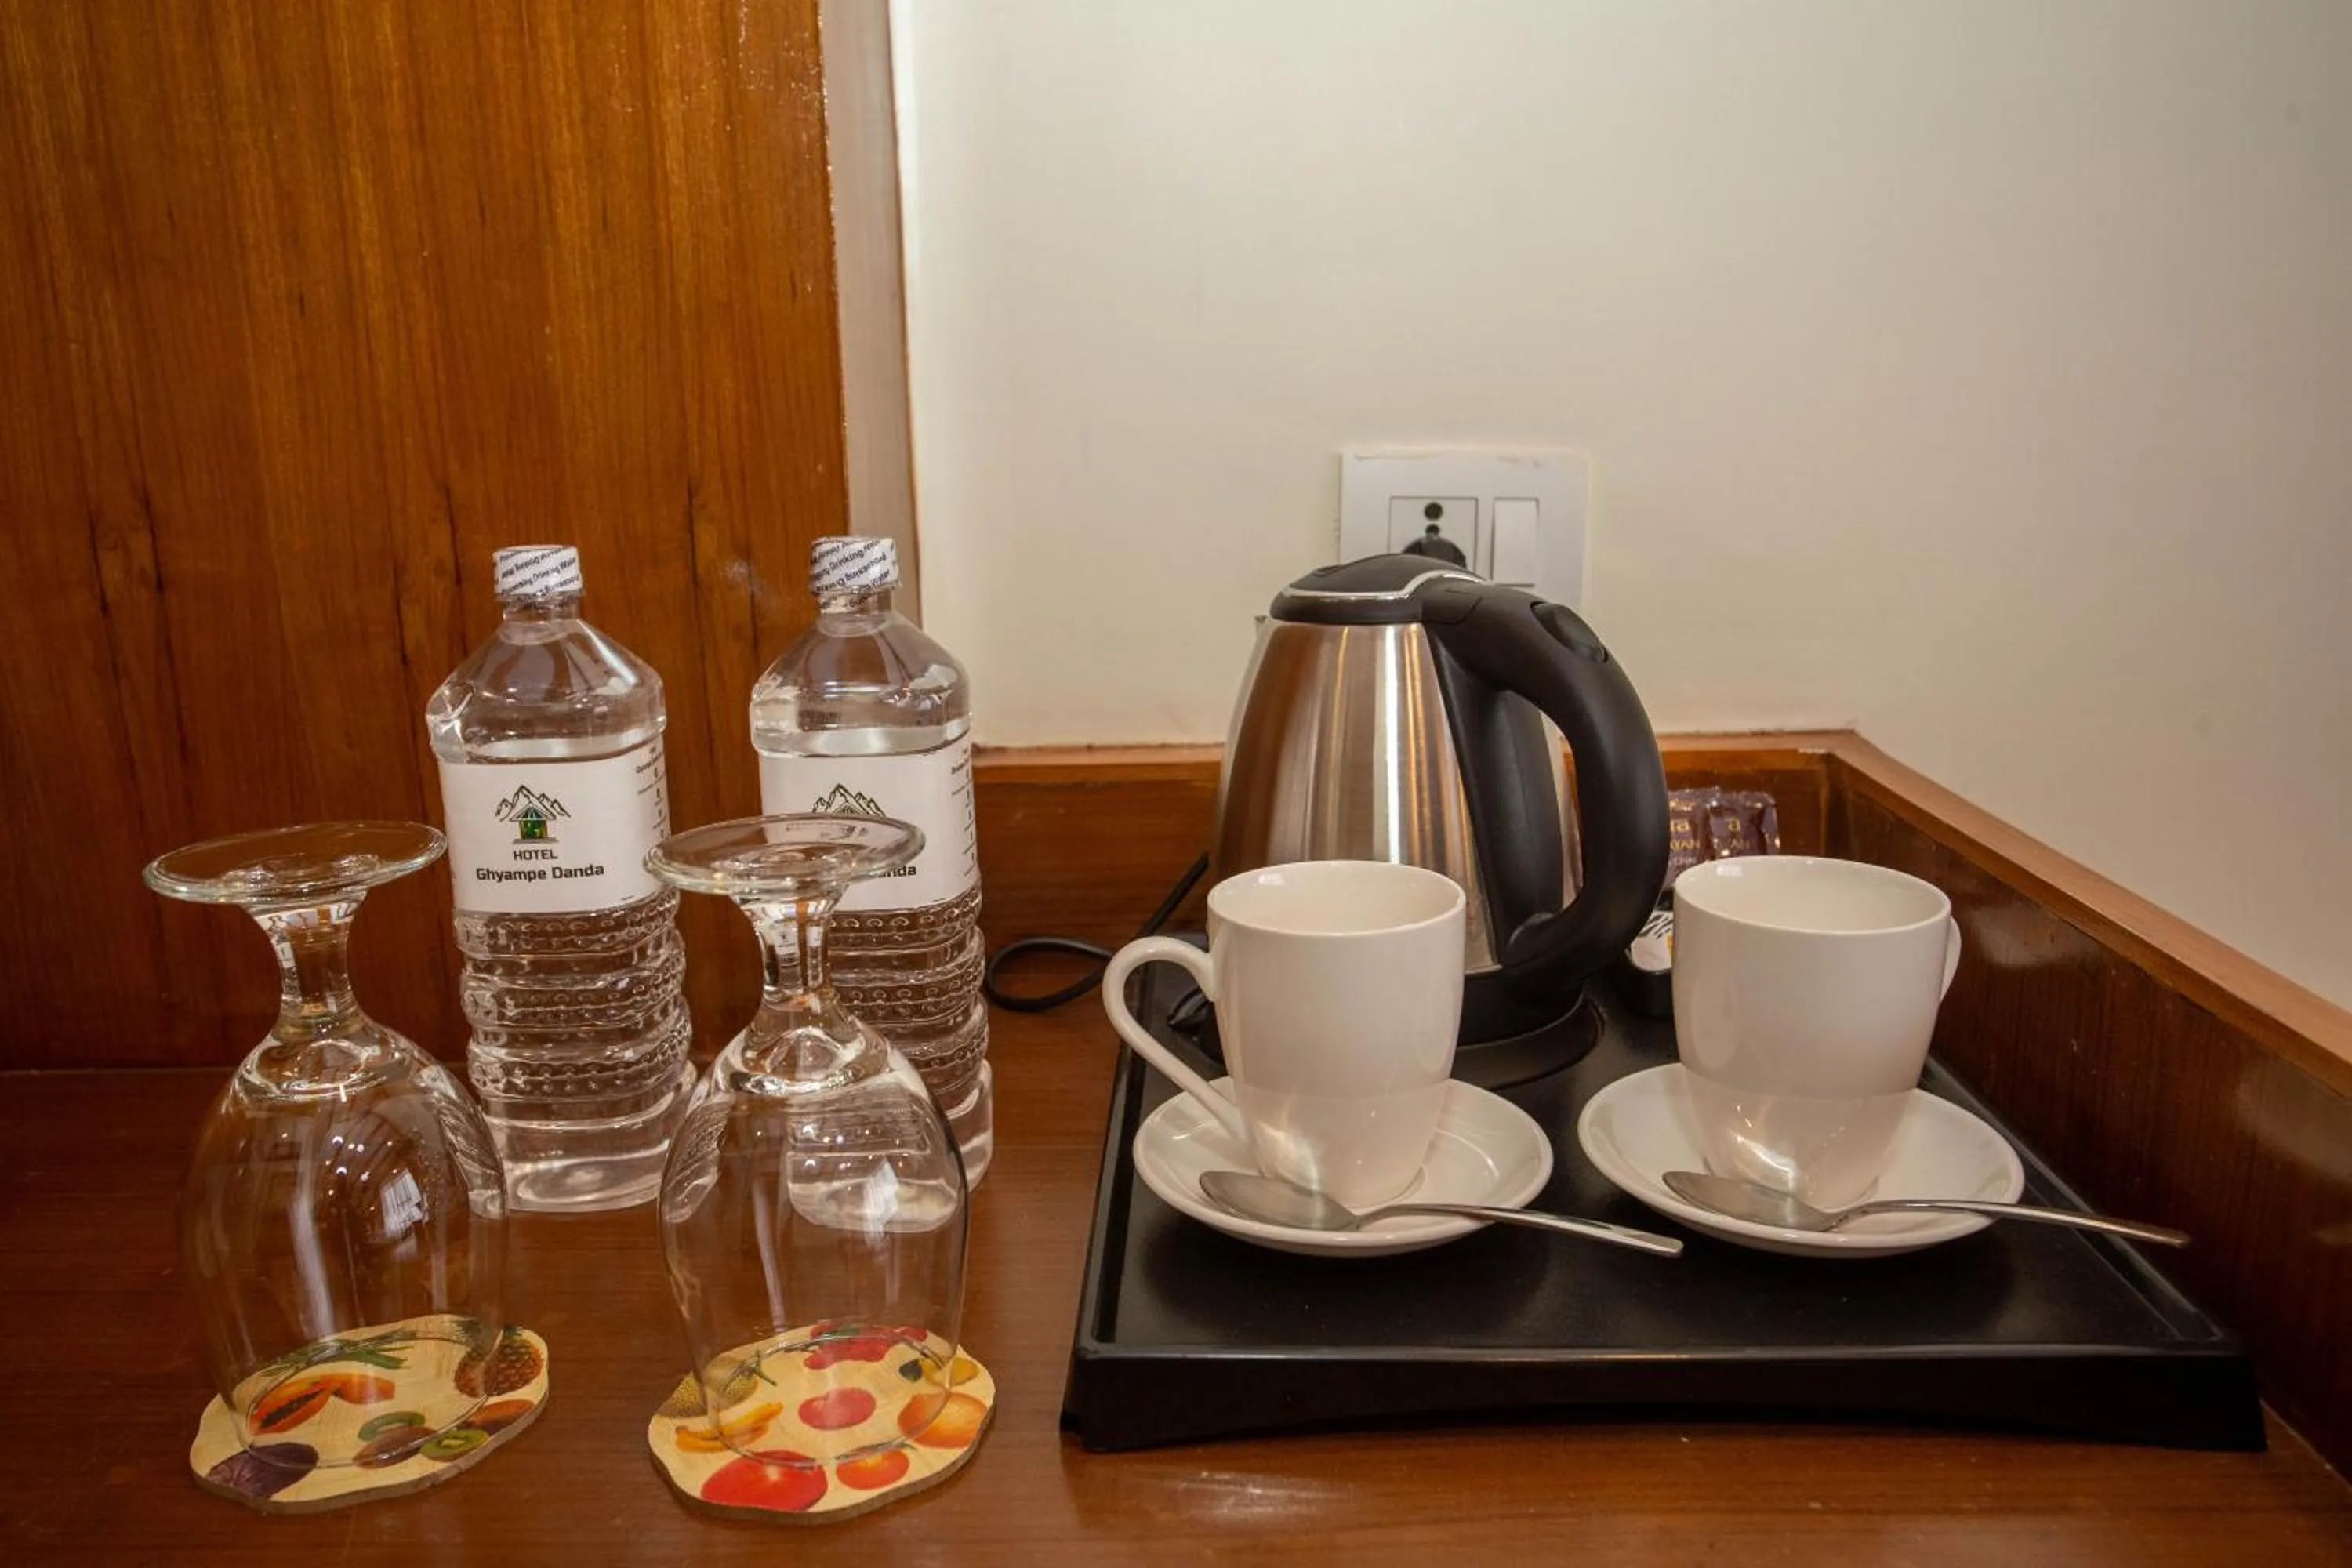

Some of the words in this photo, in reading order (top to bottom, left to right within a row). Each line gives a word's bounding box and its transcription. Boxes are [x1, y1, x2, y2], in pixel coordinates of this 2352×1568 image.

[514, 849, 558, 861] HOTEL
[475, 868, 547, 883] Ghyampe
[551, 863, 605, 880] Danda
